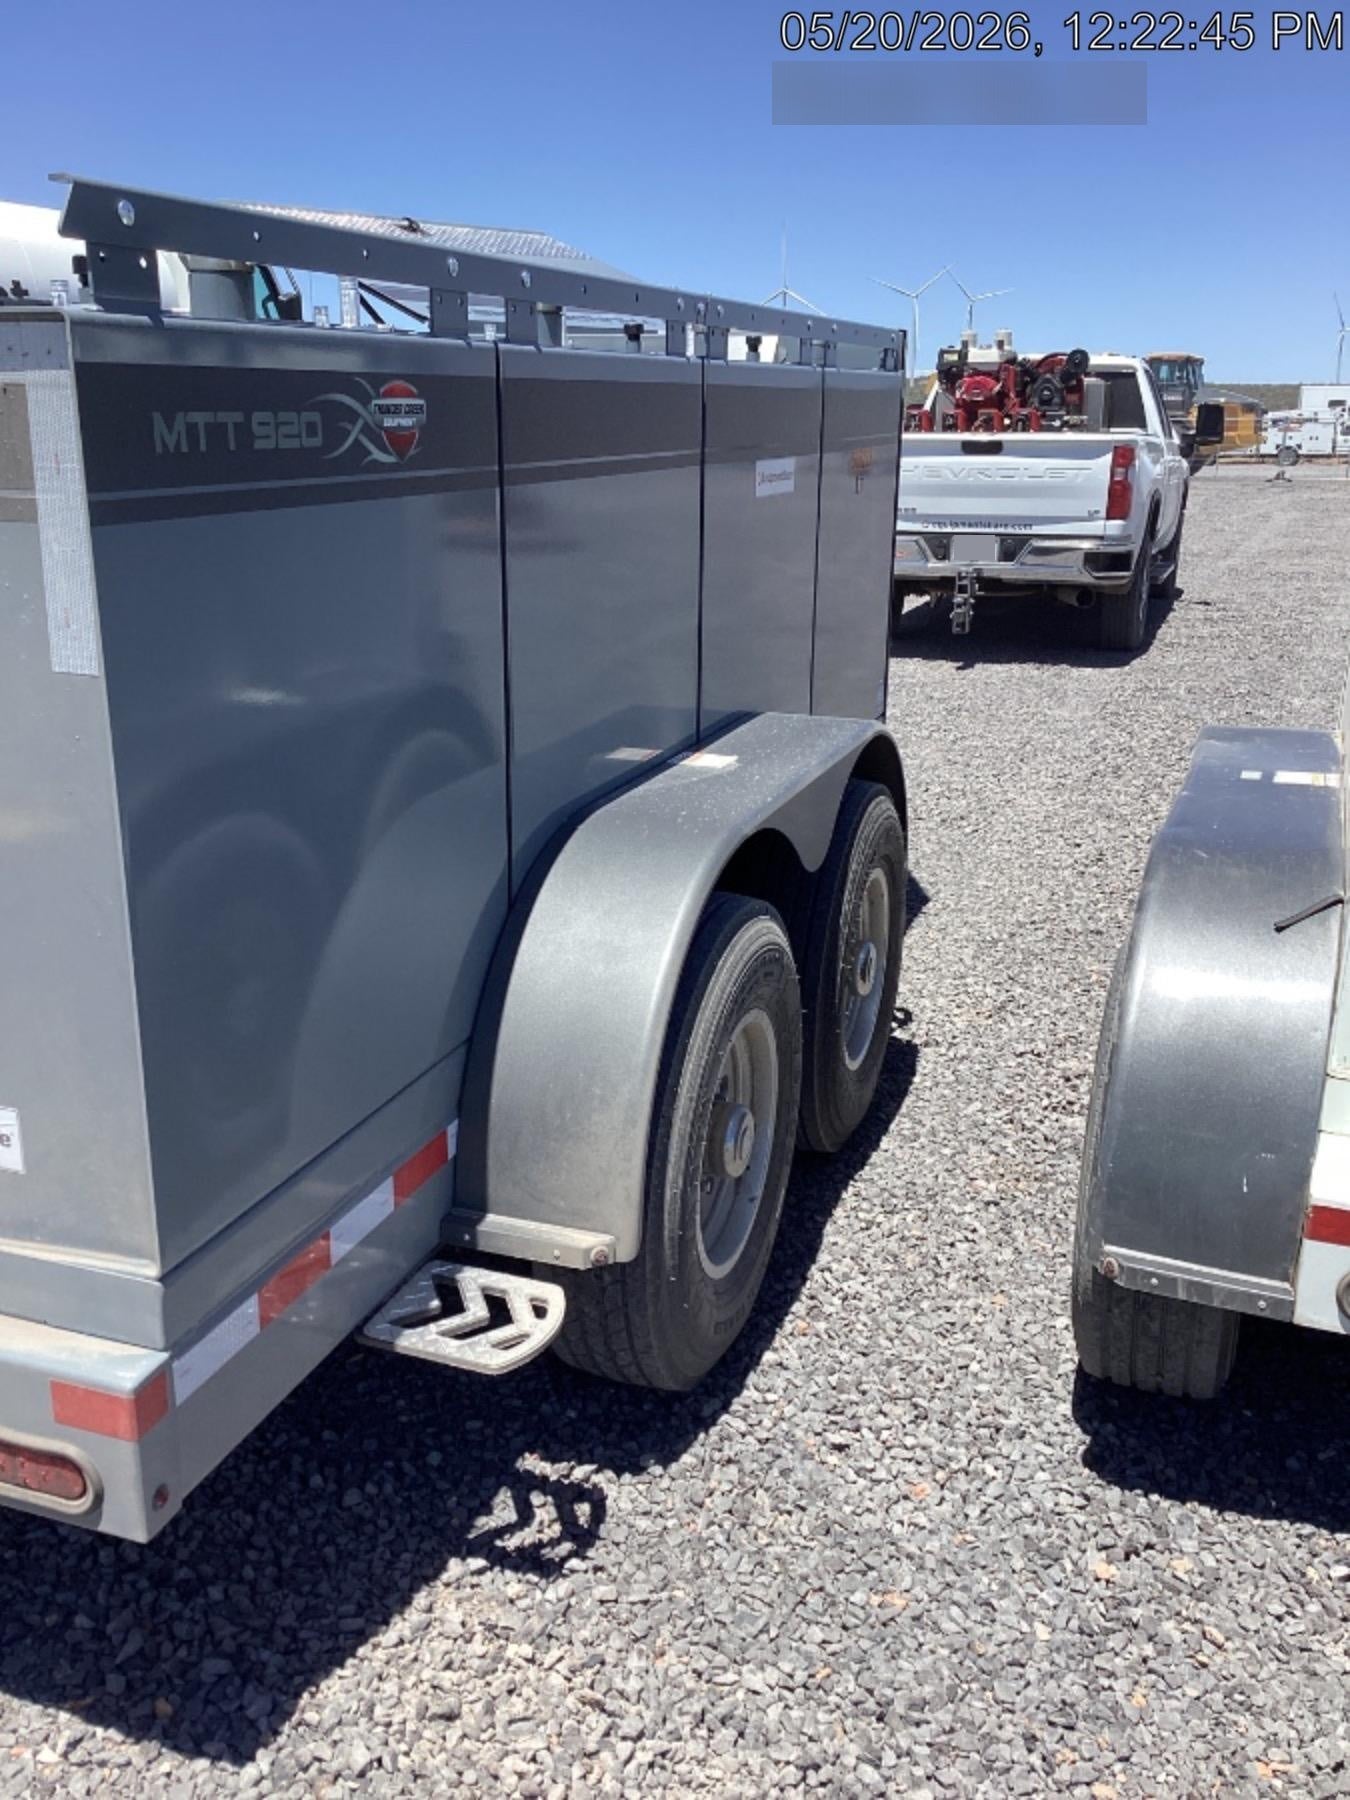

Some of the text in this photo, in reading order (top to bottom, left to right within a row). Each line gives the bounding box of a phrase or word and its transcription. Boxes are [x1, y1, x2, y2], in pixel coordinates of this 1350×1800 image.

[152, 411, 323, 453] MTT 920
[898, 465, 1092, 482] HEVROLET
